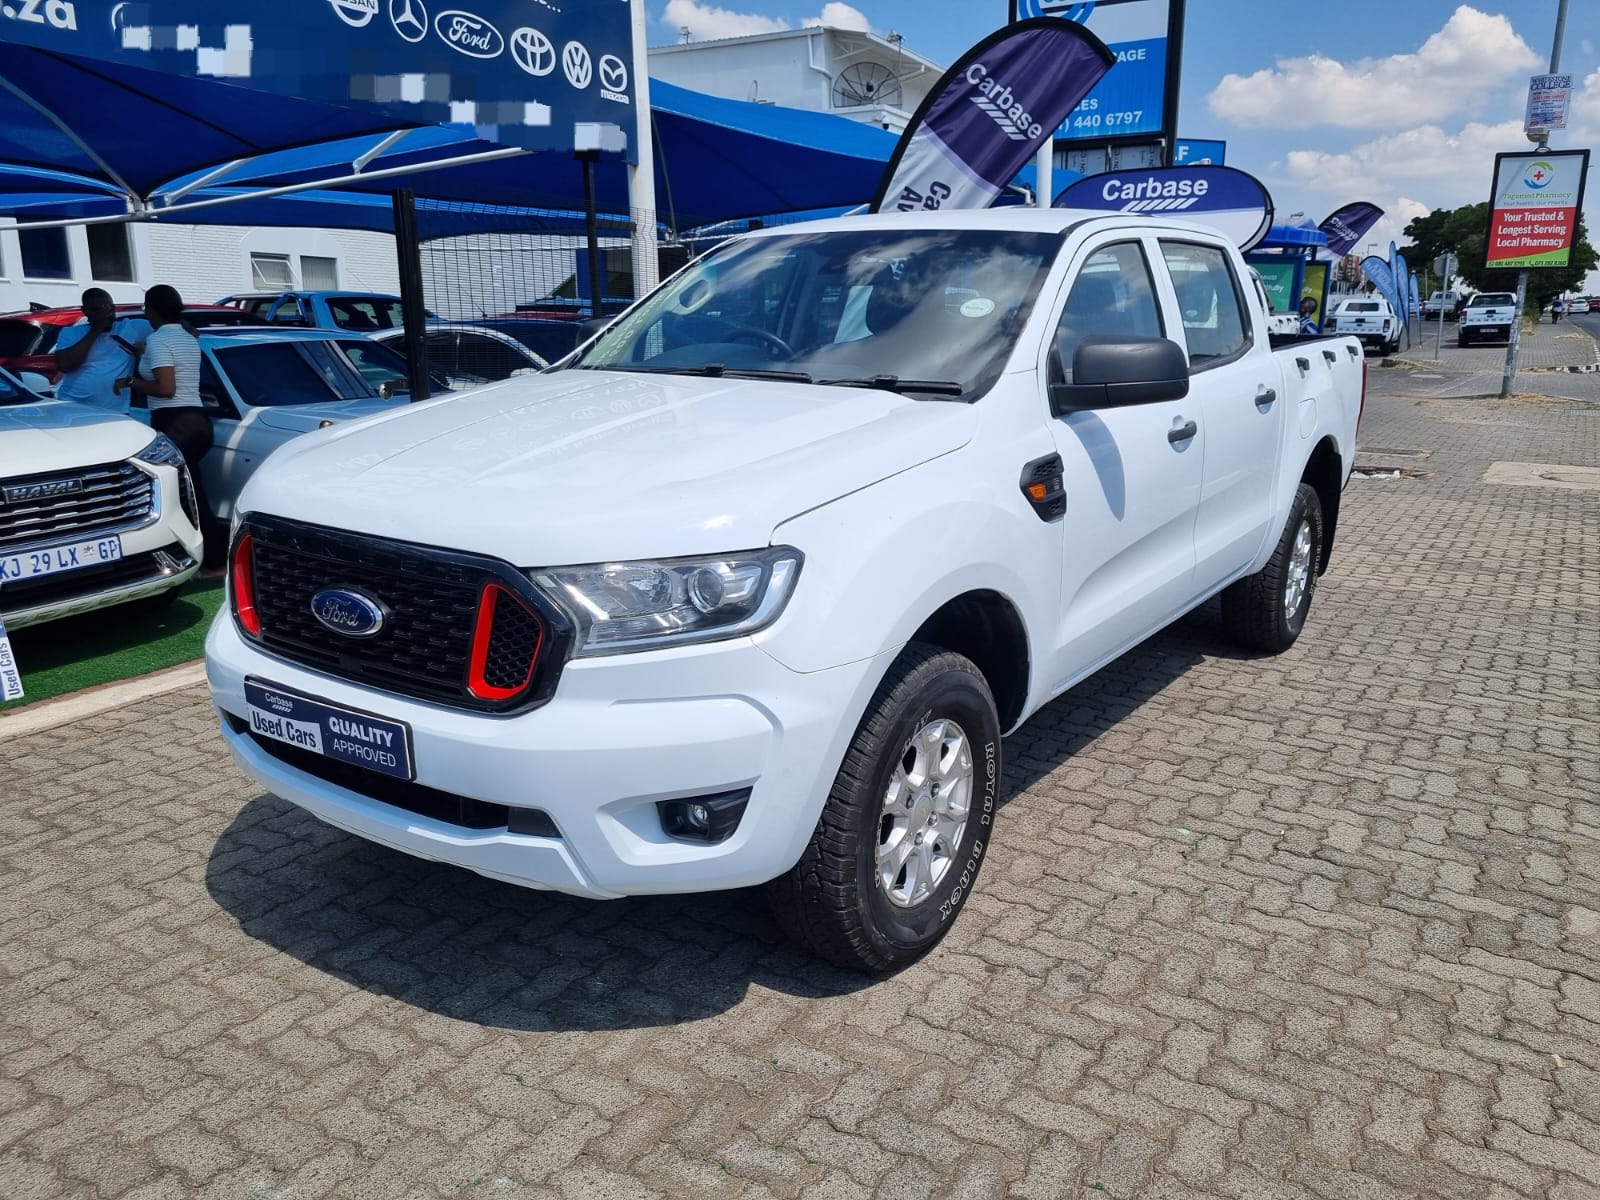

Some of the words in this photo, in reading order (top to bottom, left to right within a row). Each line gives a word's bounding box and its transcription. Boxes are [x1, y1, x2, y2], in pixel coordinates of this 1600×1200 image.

[0, 0, 77, 30] .za
[449, 17, 491, 50] Ford
[1112, 48, 1146, 62] AGE
[966, 63, 1042, 139] Carbase
[1073, 115, 1101, 128] 440
[1105, 111, 1143, 126] 6797
[1175, 146, 1189, 160] F
[921, 181, 951, 211] Ca
[1102, 177, 1208, 201] Carbase
[1498, 225, 1531, 236] Longest
[1533, 224, 1566, 235] Serving
[1504, 212, 1522, 221] Your
[1525, 211, 1556, 221] Trusted
[1557, 211, 1564, 220] &
[1497, 238, 1519, 247] Local
[1521, 237, 1564, 248] Pharmacy
[12, 481, 79, 499] HAVAL
[31, 552, 51, 574] 29
[57, 547, 79, 568] LX
[98, 540, 117, 560] GP
[322, 597, 360, 626] Ford
[0, 642, 12, 667] Cars
[3, 669, 21, 696] Used
[265, 692, 293, 708] Carbase
[252, 711, 283, 737] Used
[286, 722, 317, 748] Cars
[329, 717, 393, 747] QUALITY
[334, 738, 396, 767] APPROVED
[981, 742, 995, 825] ROYAL
[940, 840, 983, 920] BLACK
